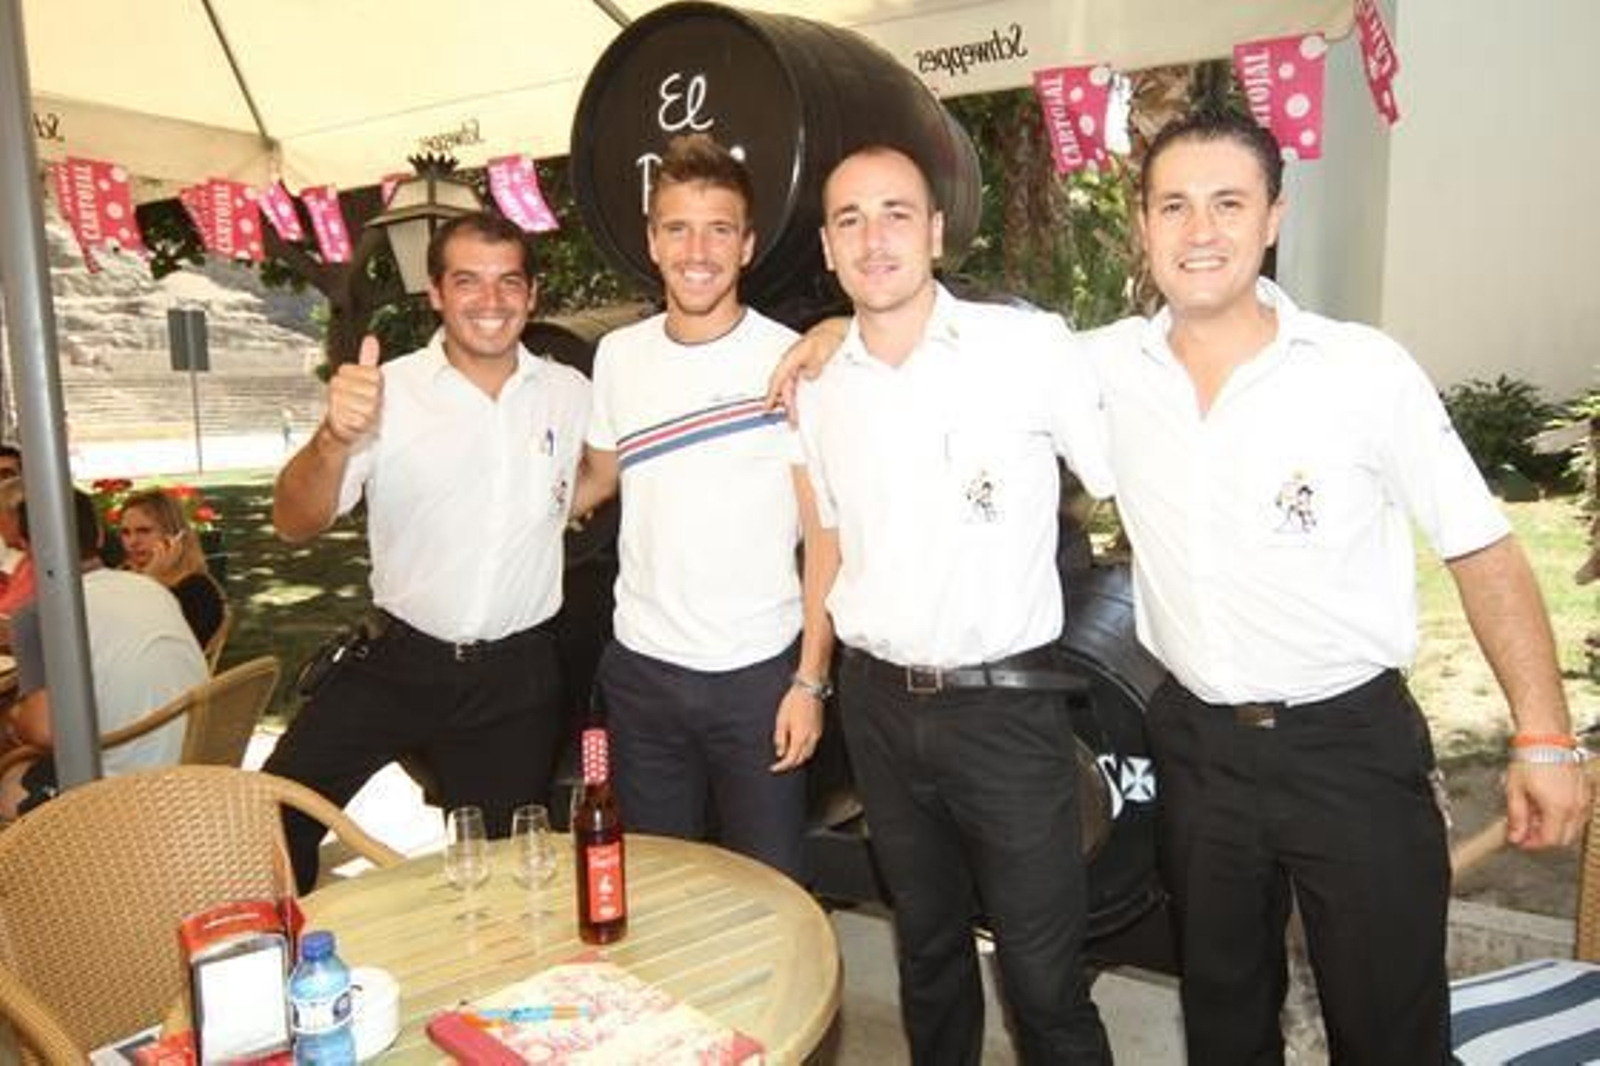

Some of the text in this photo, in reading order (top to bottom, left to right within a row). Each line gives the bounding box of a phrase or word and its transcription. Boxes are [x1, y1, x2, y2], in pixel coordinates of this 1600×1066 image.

[658, 73, 714, 131] El
[1040, 75, 1083, 166] CARTOJAL
[74, 165, 101, 240] CARTOJAL
